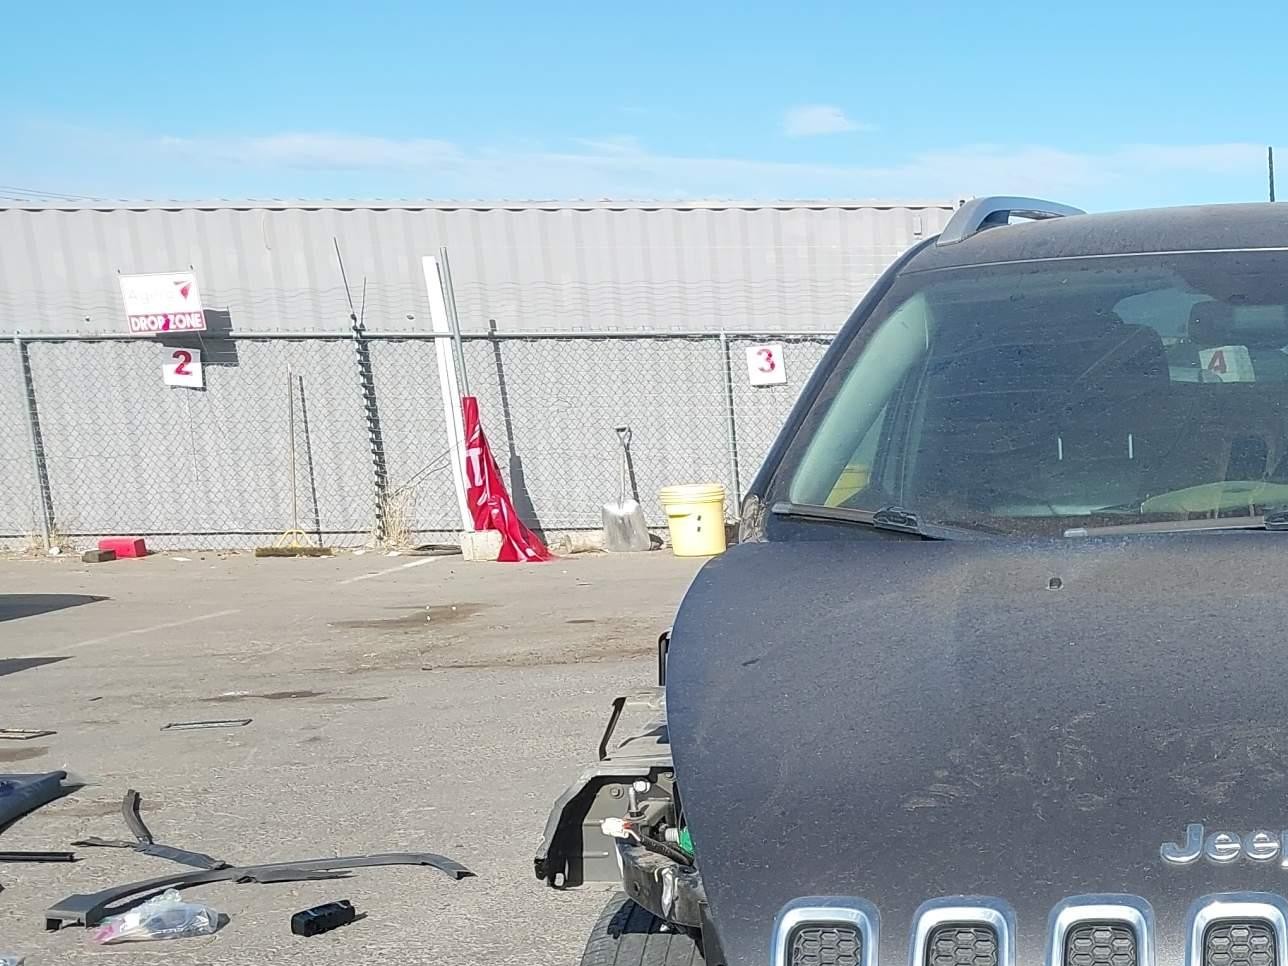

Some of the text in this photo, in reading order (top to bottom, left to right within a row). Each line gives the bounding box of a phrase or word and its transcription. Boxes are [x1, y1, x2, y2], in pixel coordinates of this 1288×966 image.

[131, 313, 202, 331] DROP ZONE
[172, 350, 192, 375] 2
[756, 348, 776, 373] 3
